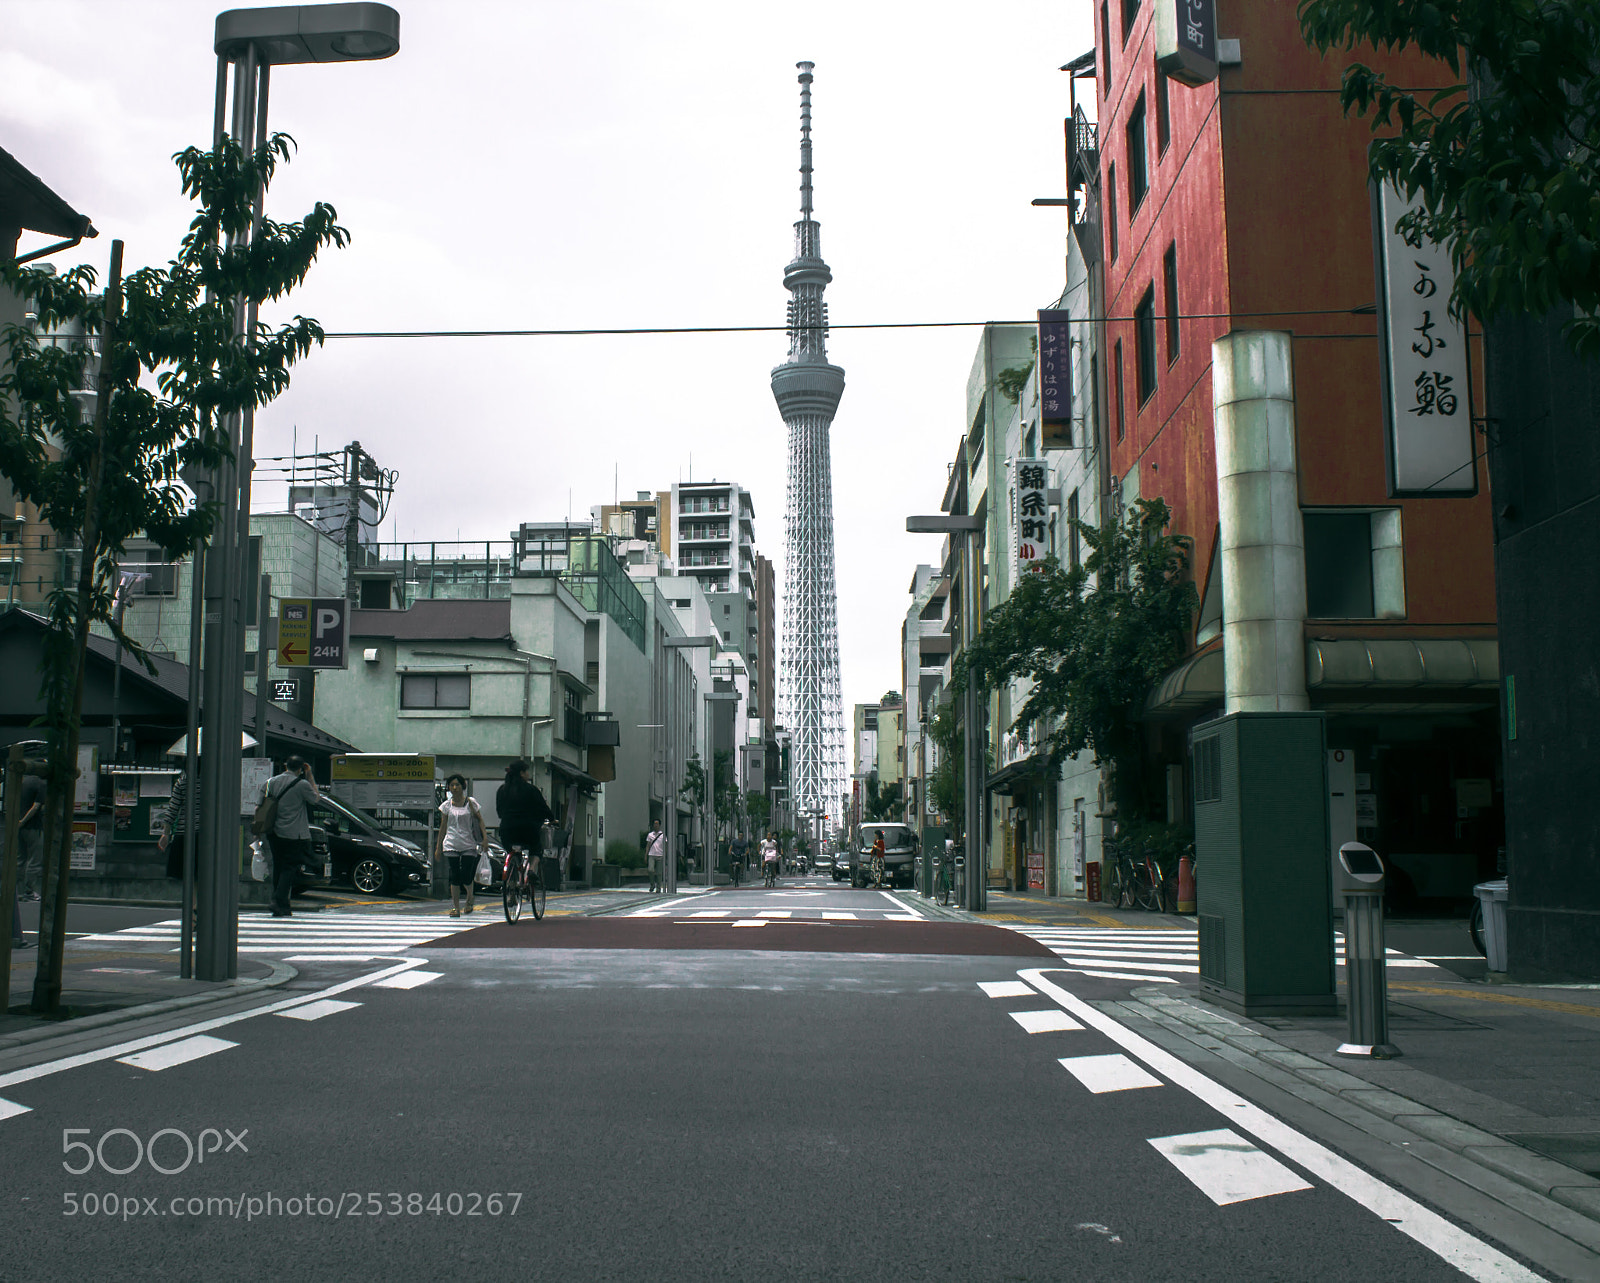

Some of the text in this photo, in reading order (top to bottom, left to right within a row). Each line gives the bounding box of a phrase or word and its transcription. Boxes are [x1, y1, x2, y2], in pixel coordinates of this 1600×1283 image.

[1043, 334, 1060, 412] ゆずりはの湯
[316, 608, 341, 639] P
[313, 646, 340, 657] 24H
[274, 680, 295, 700] 空
